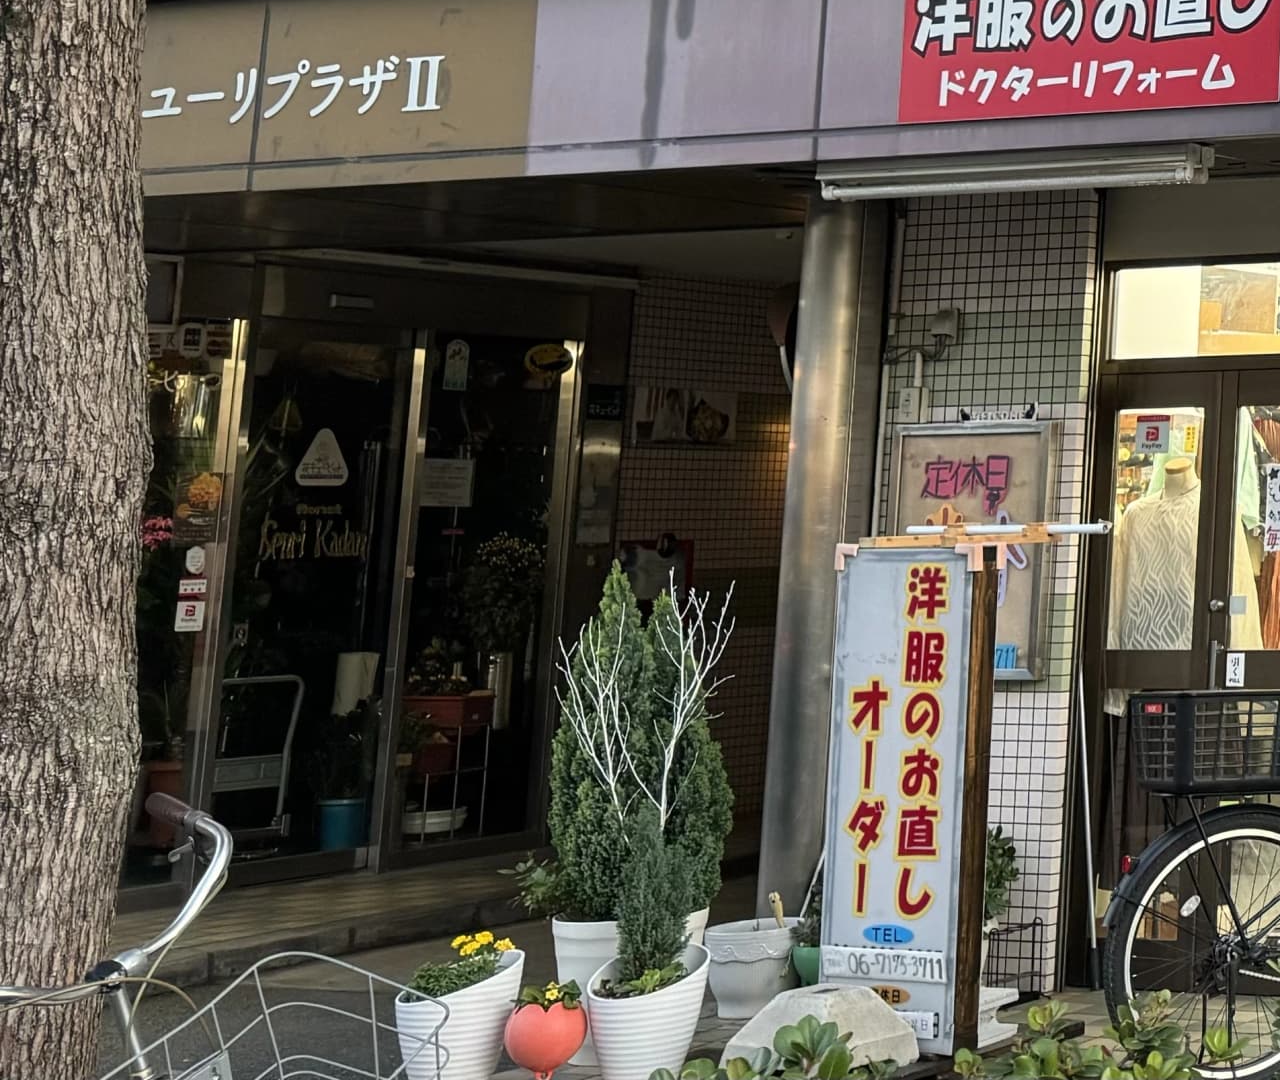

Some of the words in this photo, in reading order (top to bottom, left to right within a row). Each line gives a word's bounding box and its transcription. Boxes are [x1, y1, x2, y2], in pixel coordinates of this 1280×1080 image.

[938, 53, 1237, 108] ドクターリフォーム
[920, 455, 1010, 500] 定休日
[896, 564, 949, 919] 洋服のお直し
[845, 678, 894, 917] オーダー
[870, 926, 905, 943] TEL
